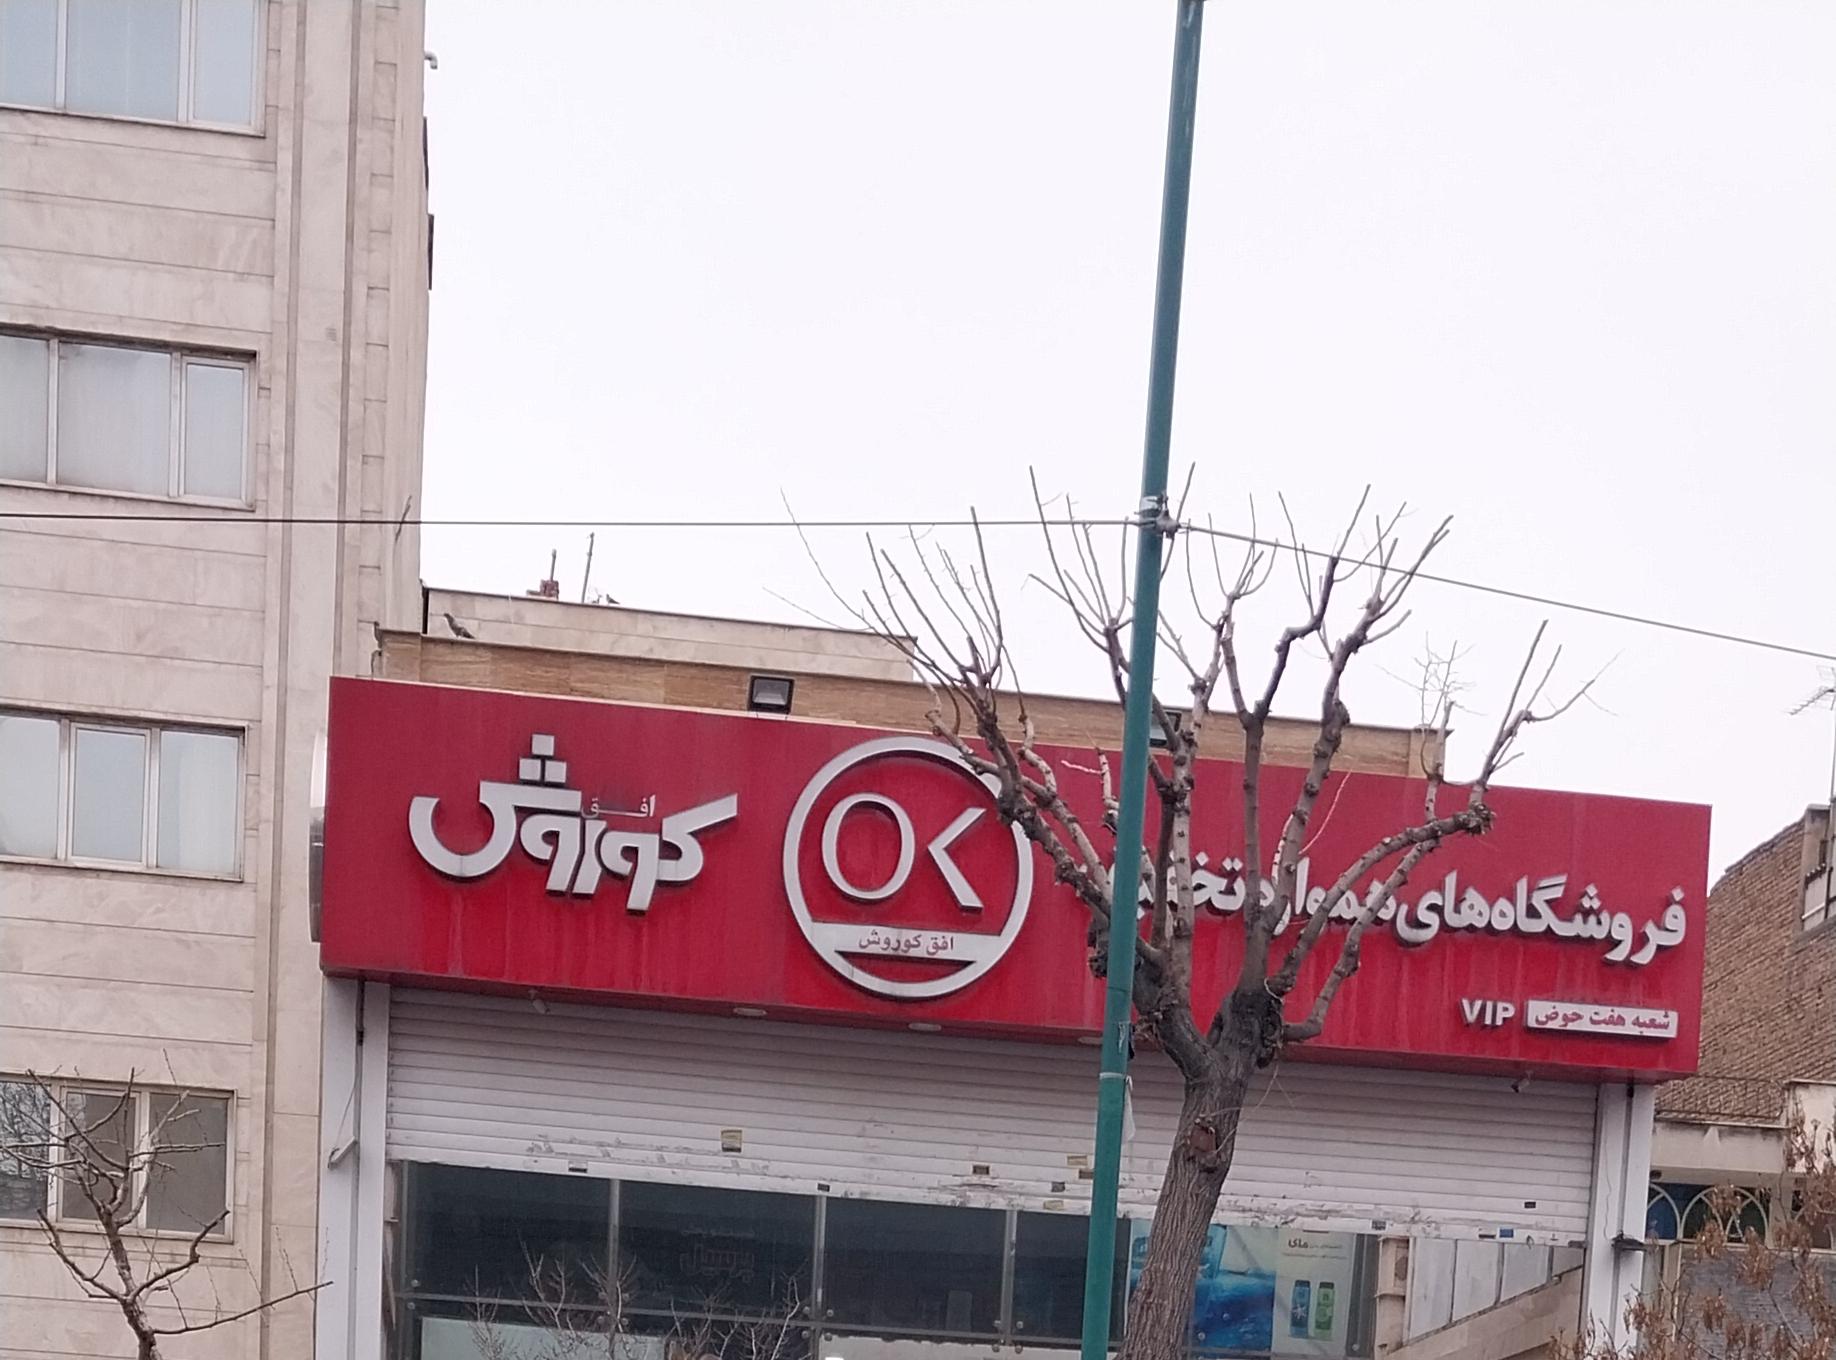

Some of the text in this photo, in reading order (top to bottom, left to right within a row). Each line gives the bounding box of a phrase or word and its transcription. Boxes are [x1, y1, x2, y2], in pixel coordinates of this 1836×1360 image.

[408, 733, 738, 912] افق کوروش
[858, 929, 954, 956] افق کوروش
[1461, 998, 1516, 1027] VIP
[1535, 1006, 1670, 1034] شعبه هفت حوض
